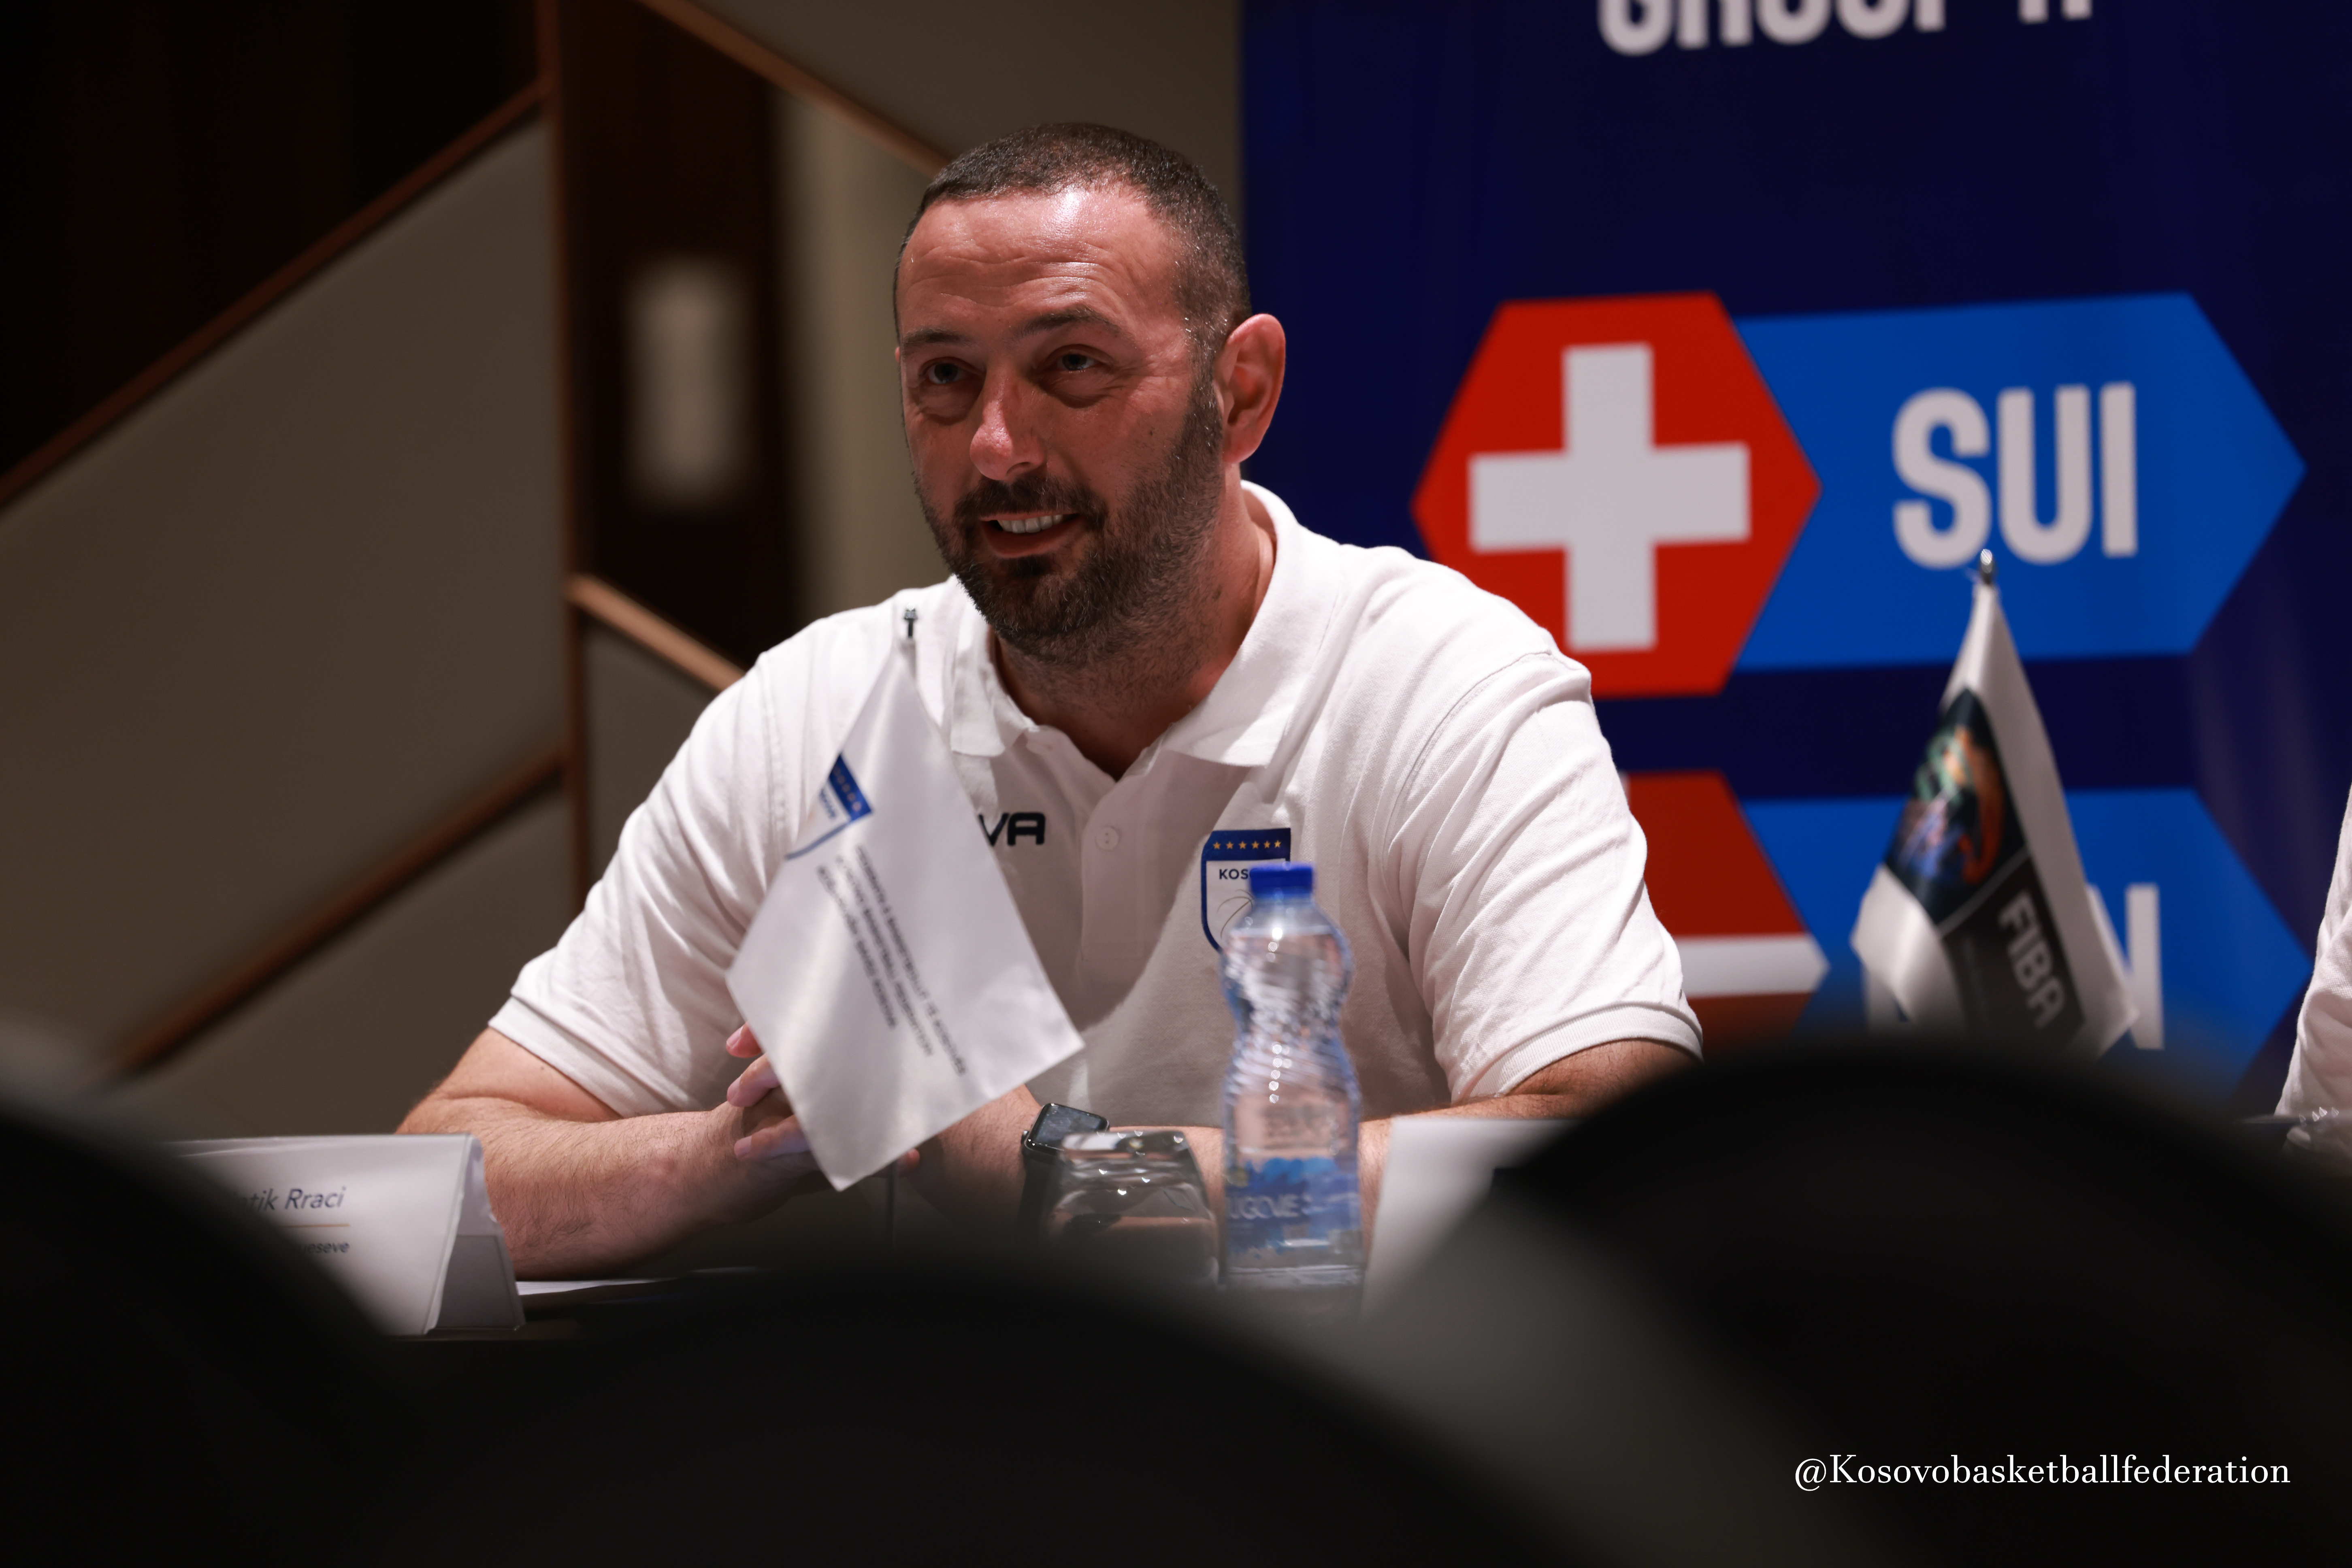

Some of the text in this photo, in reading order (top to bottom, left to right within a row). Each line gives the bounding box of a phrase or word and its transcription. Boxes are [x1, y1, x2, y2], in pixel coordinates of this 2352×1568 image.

[1892, 381, 2137, 569] SUI
[978, 812, 1045, 846] VA
[1219, 868, 1249, 880] KOS
[1997, 888, 2065, 1031] FIBA
[240, 1185, 347, 1211] tik Rraci
[1226, 1194, 1299, 1220] UGOVE
[307, 1242, 351, 1253] eseve
